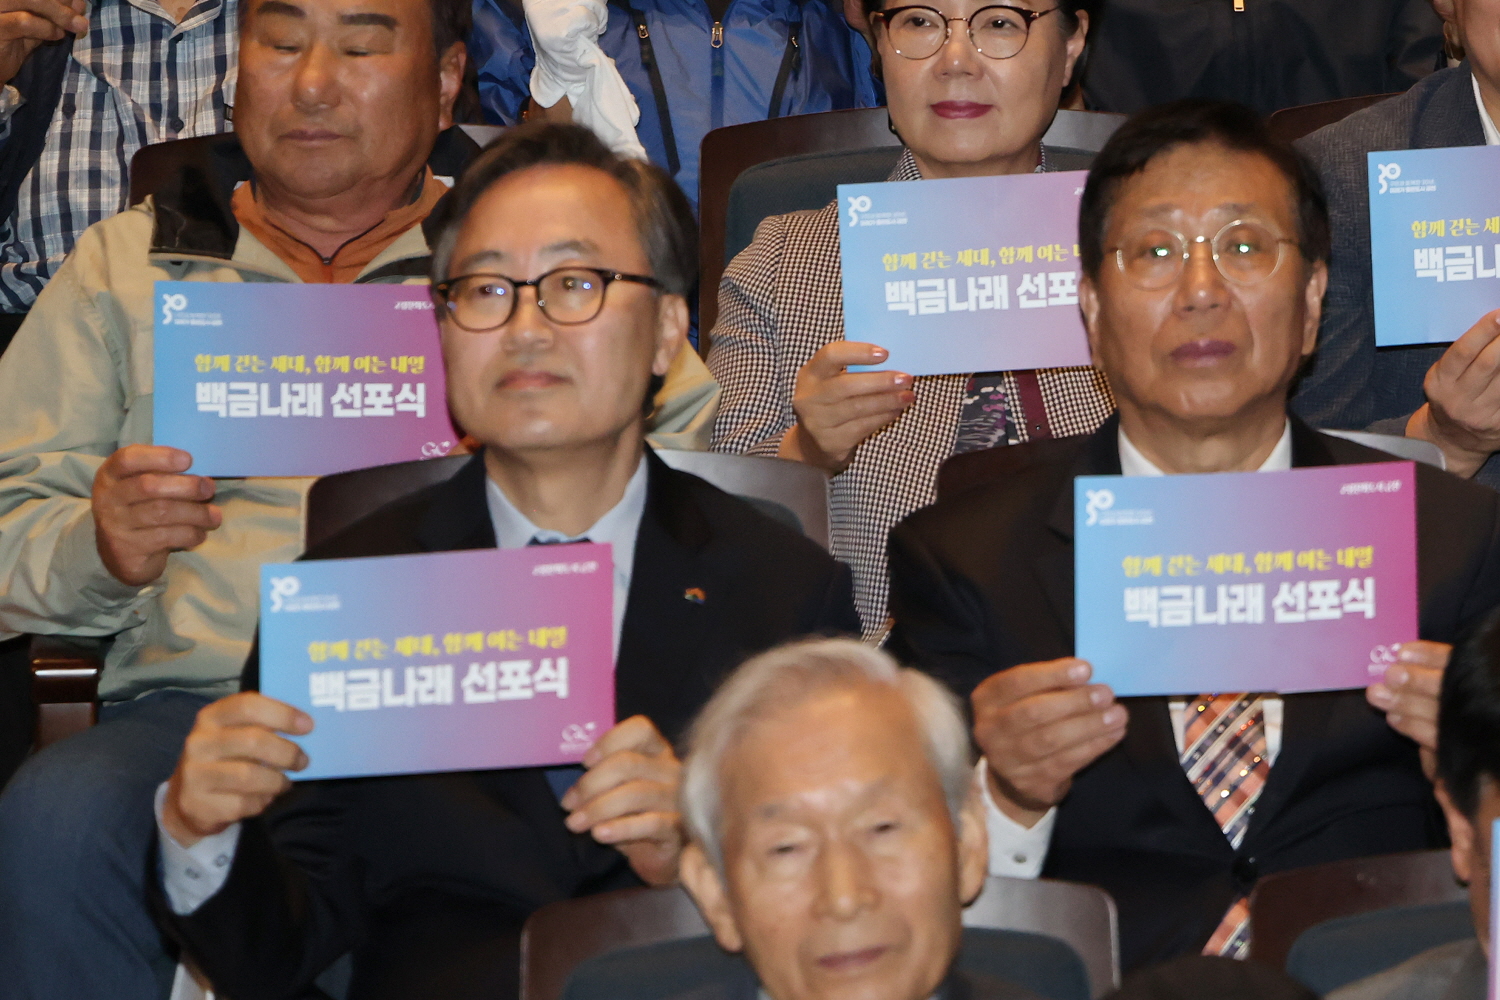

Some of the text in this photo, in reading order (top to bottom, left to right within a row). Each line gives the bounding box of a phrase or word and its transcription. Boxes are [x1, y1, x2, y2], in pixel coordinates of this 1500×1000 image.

[1411, 219, 1445, 239] 함께
[885, 271, 1079, 316] 백금나래 선포
[196, 382, 424, 417] 백금나래 선포식
[1124, 578, 1374, 629] 백금나래 선포식
[310, 657, 567, 713] 백금나래 선포식
